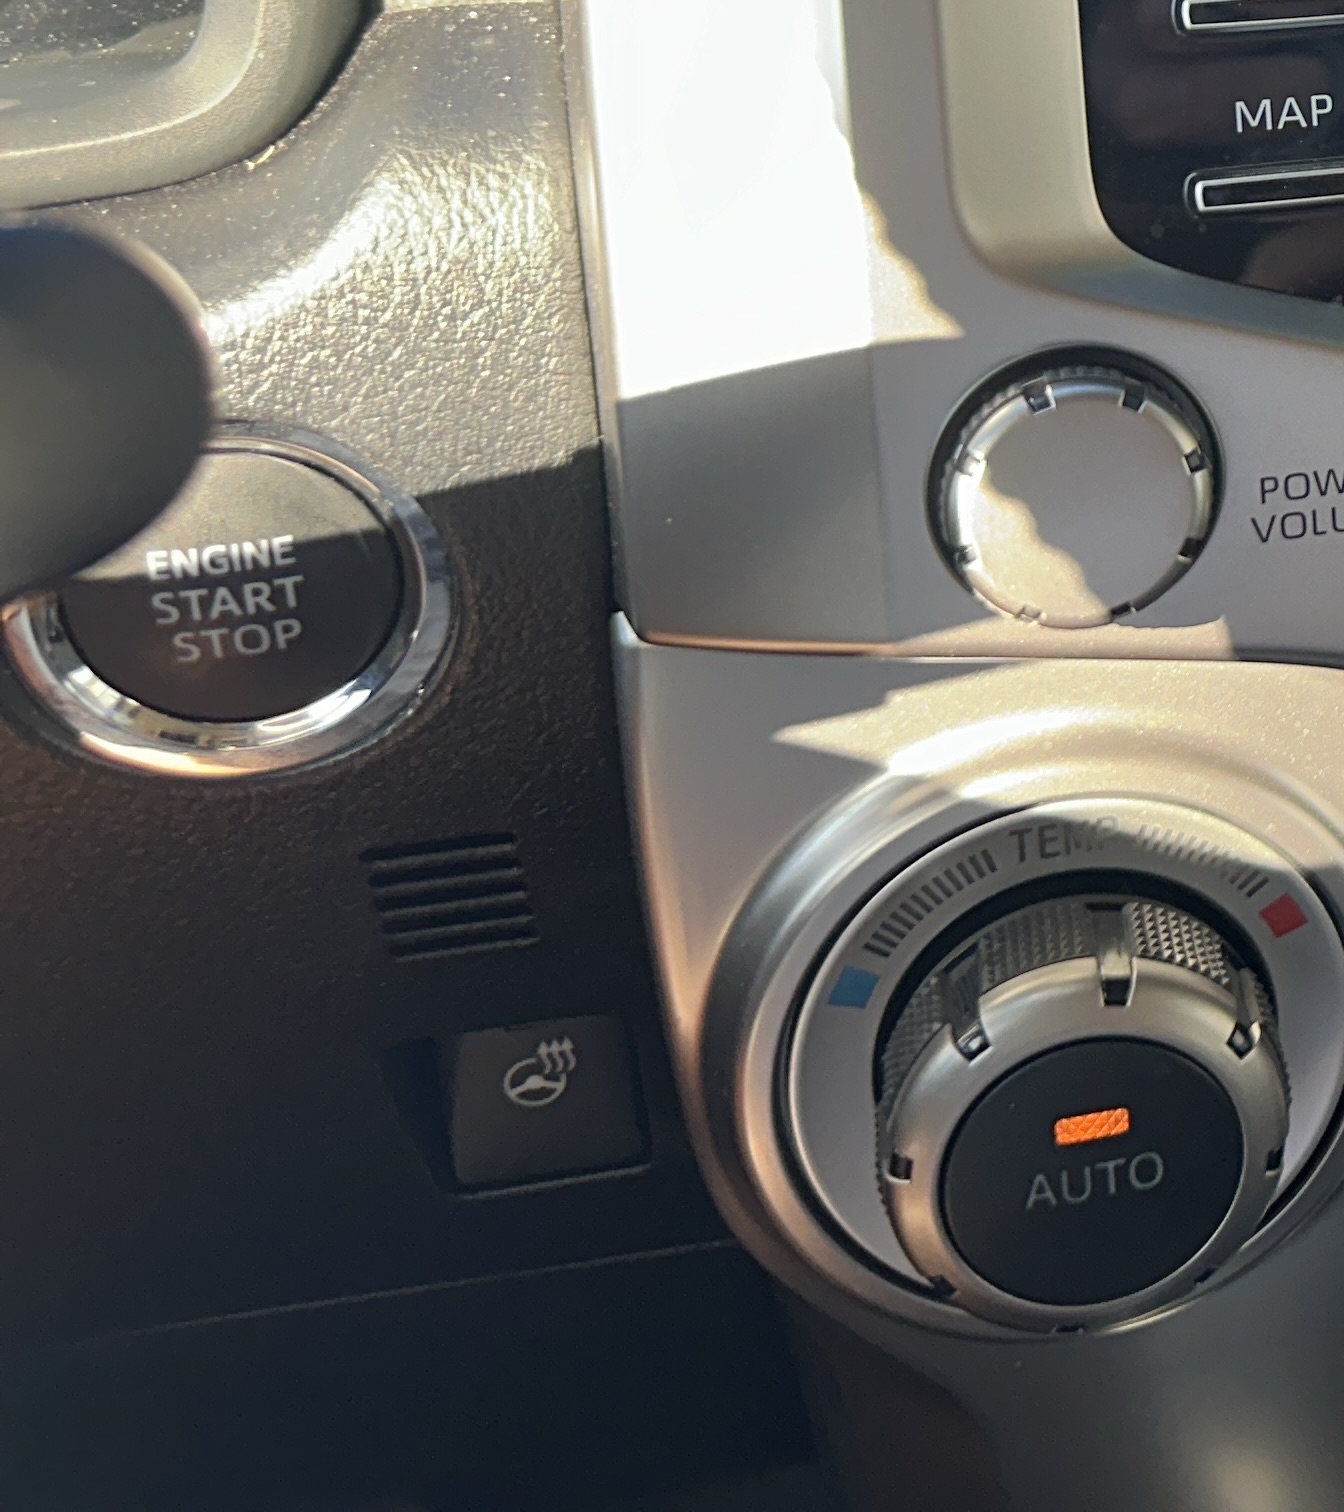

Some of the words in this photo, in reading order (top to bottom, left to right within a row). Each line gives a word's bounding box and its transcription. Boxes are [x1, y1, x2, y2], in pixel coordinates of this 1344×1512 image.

[1234, 93, 1335, 133] MAP
[146, 534, 296, 584] ENGINE
[151, 575, 305, 626] START
[171, 617, 304, 663] STOP
[1008, 814, 1121, 864] TEMP
[1025, 1151, 1165, 1211] AUTO
